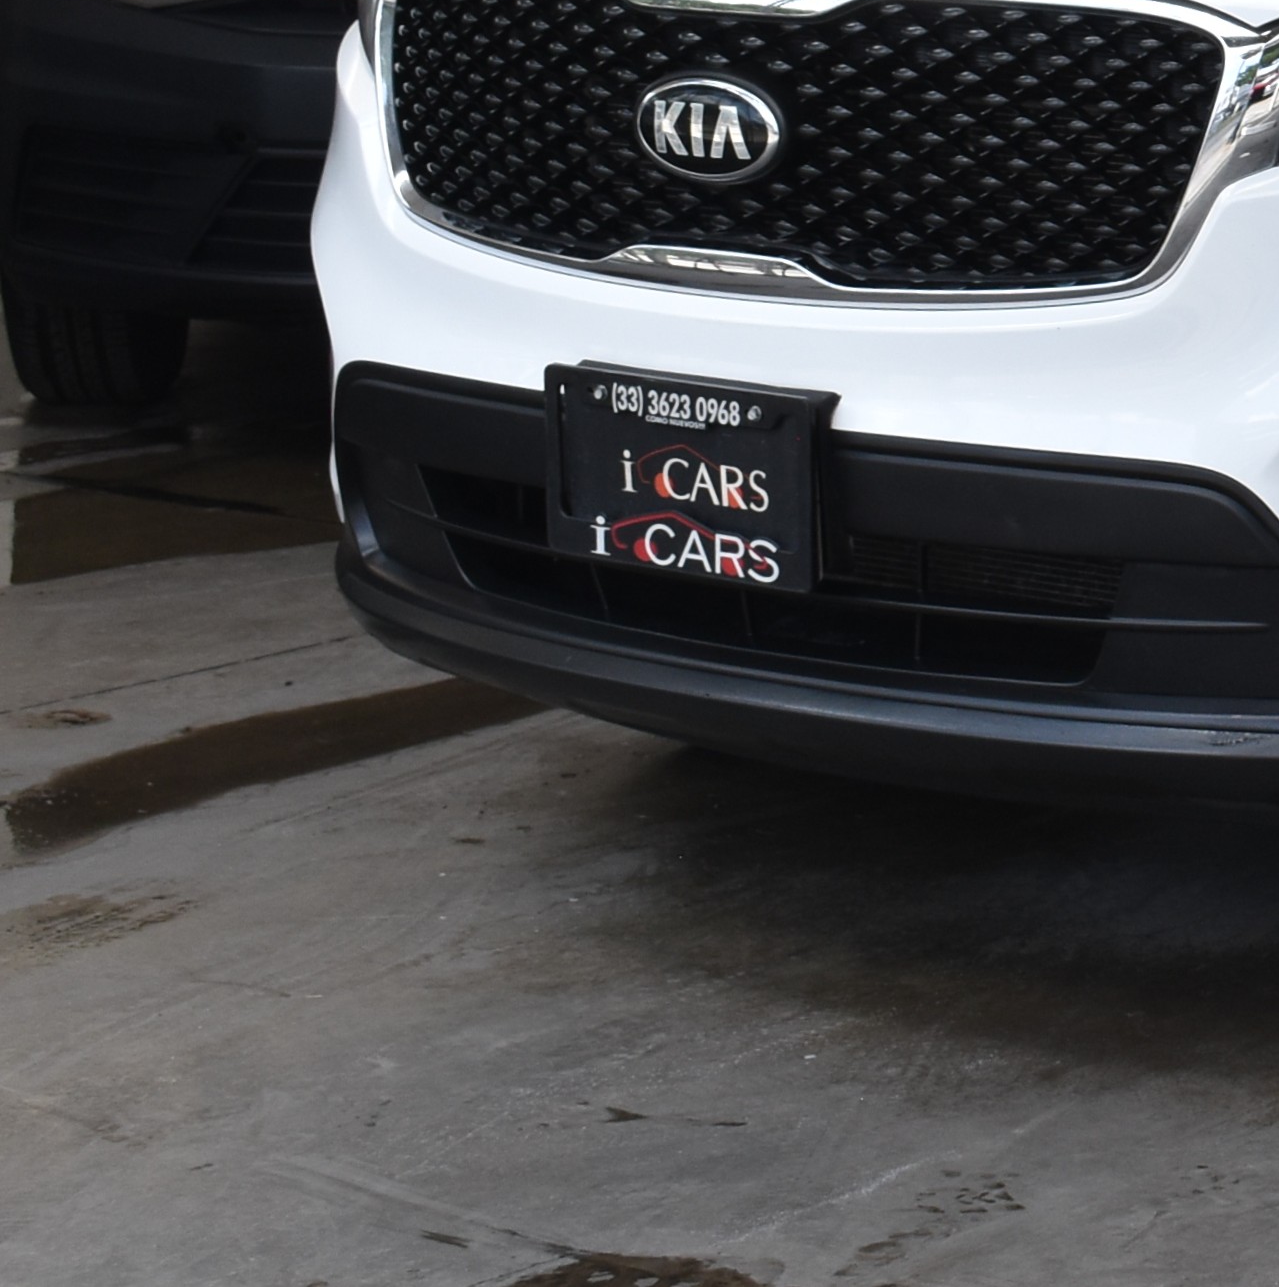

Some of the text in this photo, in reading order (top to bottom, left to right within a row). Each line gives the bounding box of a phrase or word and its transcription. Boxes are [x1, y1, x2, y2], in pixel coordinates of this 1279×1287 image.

[654, 100, 751, 159] KIA
[612, 382, 740, 426] (33) 3623 0968
[645, 414, 668, 424] COMO
[620, 449, 769, 512] i CARS
[590, 515, 780, 583] i CARS
